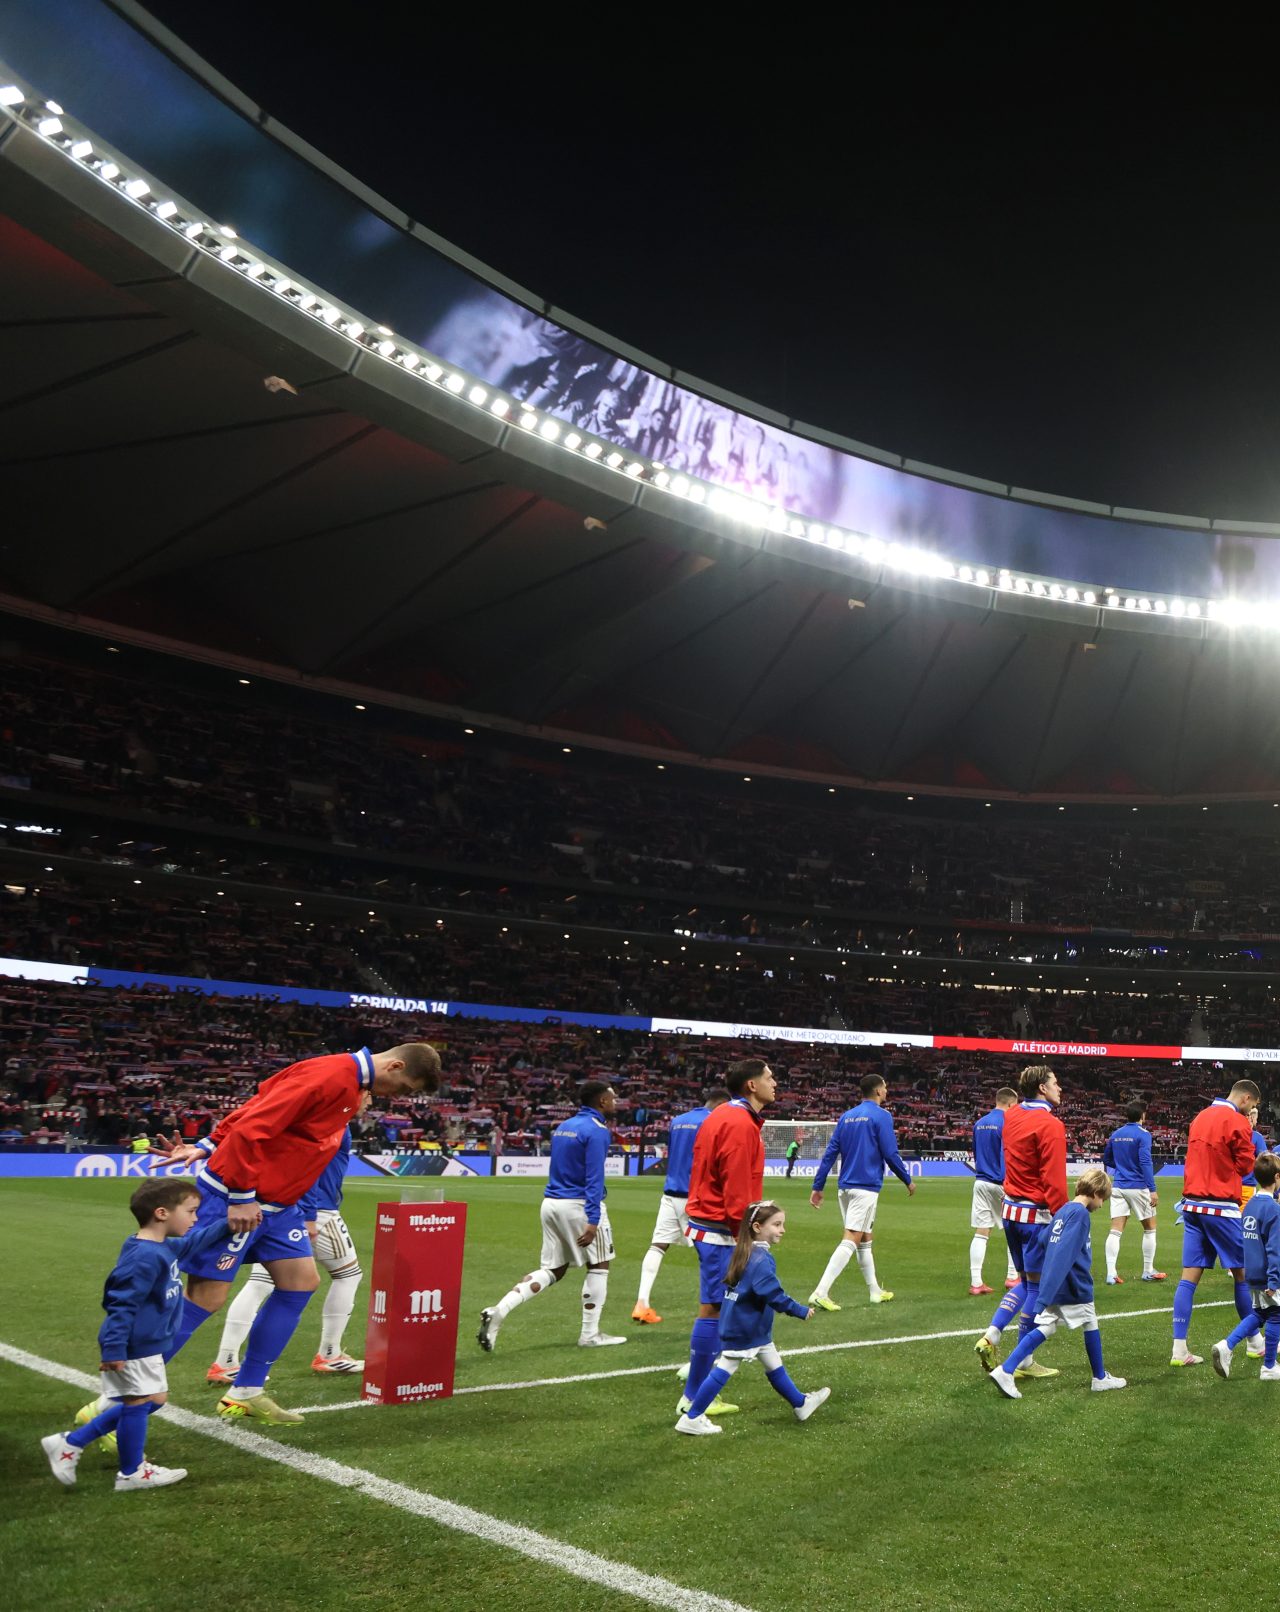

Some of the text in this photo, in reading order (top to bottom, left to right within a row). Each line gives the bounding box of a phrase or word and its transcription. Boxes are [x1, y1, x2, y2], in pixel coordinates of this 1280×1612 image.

[350, 994, 448, 1015] JORNADA 14
[740, 1027, 866, 1043] RIYADH AIR METROPOLITANO
[1012, 1041, 1057, 1054] ATLÉTICO
[1068, 1045, 1107, 1056] MADRID
[409, 1213, 456, 1226] Mahou
[227, 1230, 251, 1253] 9
[396, 1382, 444, 1397] Mahou
